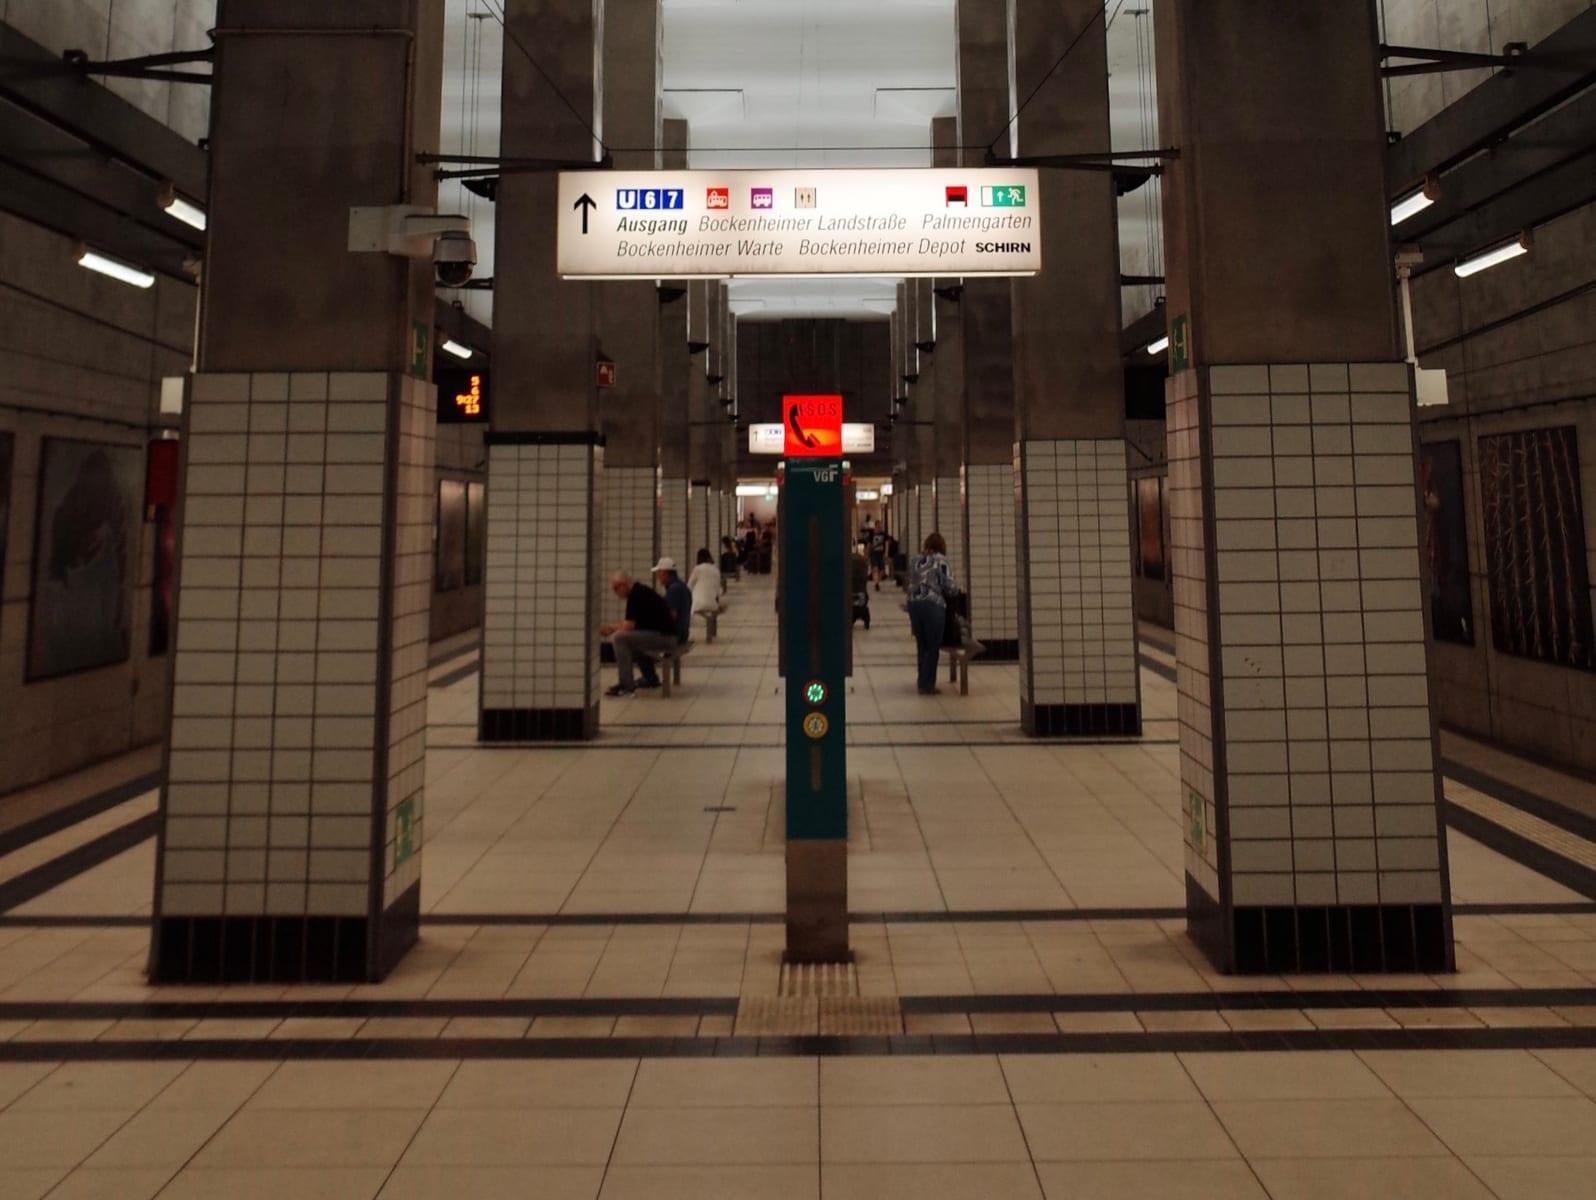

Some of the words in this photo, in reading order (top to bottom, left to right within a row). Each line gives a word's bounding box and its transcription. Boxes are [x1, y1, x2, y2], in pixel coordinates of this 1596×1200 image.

[618, 189, 637, 209] U
[644, 189, 656, 208] 6
[667, 189, 679, 208] 7
[616, 216, 688, 235] Ausgang
[698, 215, 812, 232] Bockenheimer
[817, 213, 907, 231] Landstraße
[922, 213, 1032, 232] Palmengarten
[616, 240, 732, 257] Bockenheimer
[737, 239, 784, 256] Warte
[799, 238, 914, 255] Bockenheimer
[918, 237, 965, 257] Depot
[975, 241, 1031, 253] SCHIRN
[806, 403, 837, 416] SOS
[813, 464, 838, 482] VGF
